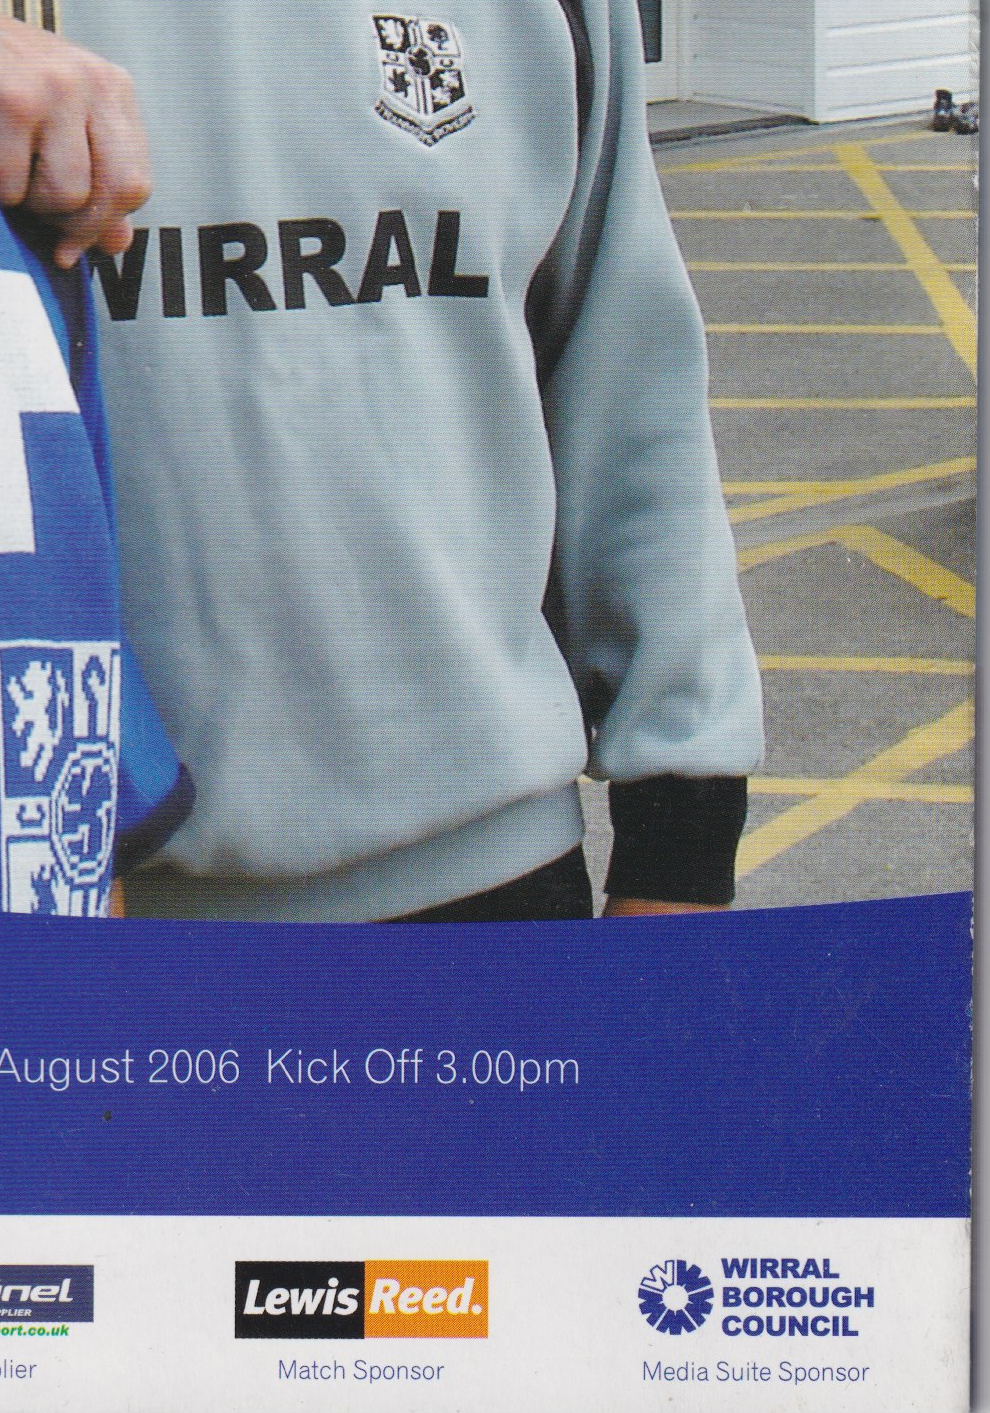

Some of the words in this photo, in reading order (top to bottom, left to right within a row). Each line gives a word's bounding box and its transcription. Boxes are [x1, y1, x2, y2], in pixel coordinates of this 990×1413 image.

[148, 1049, 240, 1084] 2006
[267, 1048, 351, 1084] Kick
[364, 1048, 424, 1085] Off
[436, 1049, 579, 1092] 3.00pm
[720, 1257, 840, 1280] WIRRAL
[242, 1277, 360, 1316] Lewis
[370, 1277, 482, 1315] Reed.
[722, 1286, 875, 1309] BOROUGH
[721, 1314, 859, 1337] COUNCIL
[278, 1359, 346, 1380] Match
[353, 1359, 445, 1384] Sponsor
[643, 1360, 710, 1382] Media
[716, 1360, 772, 1382] Suite
[778, 1360, 870, 1386] Sponsor
